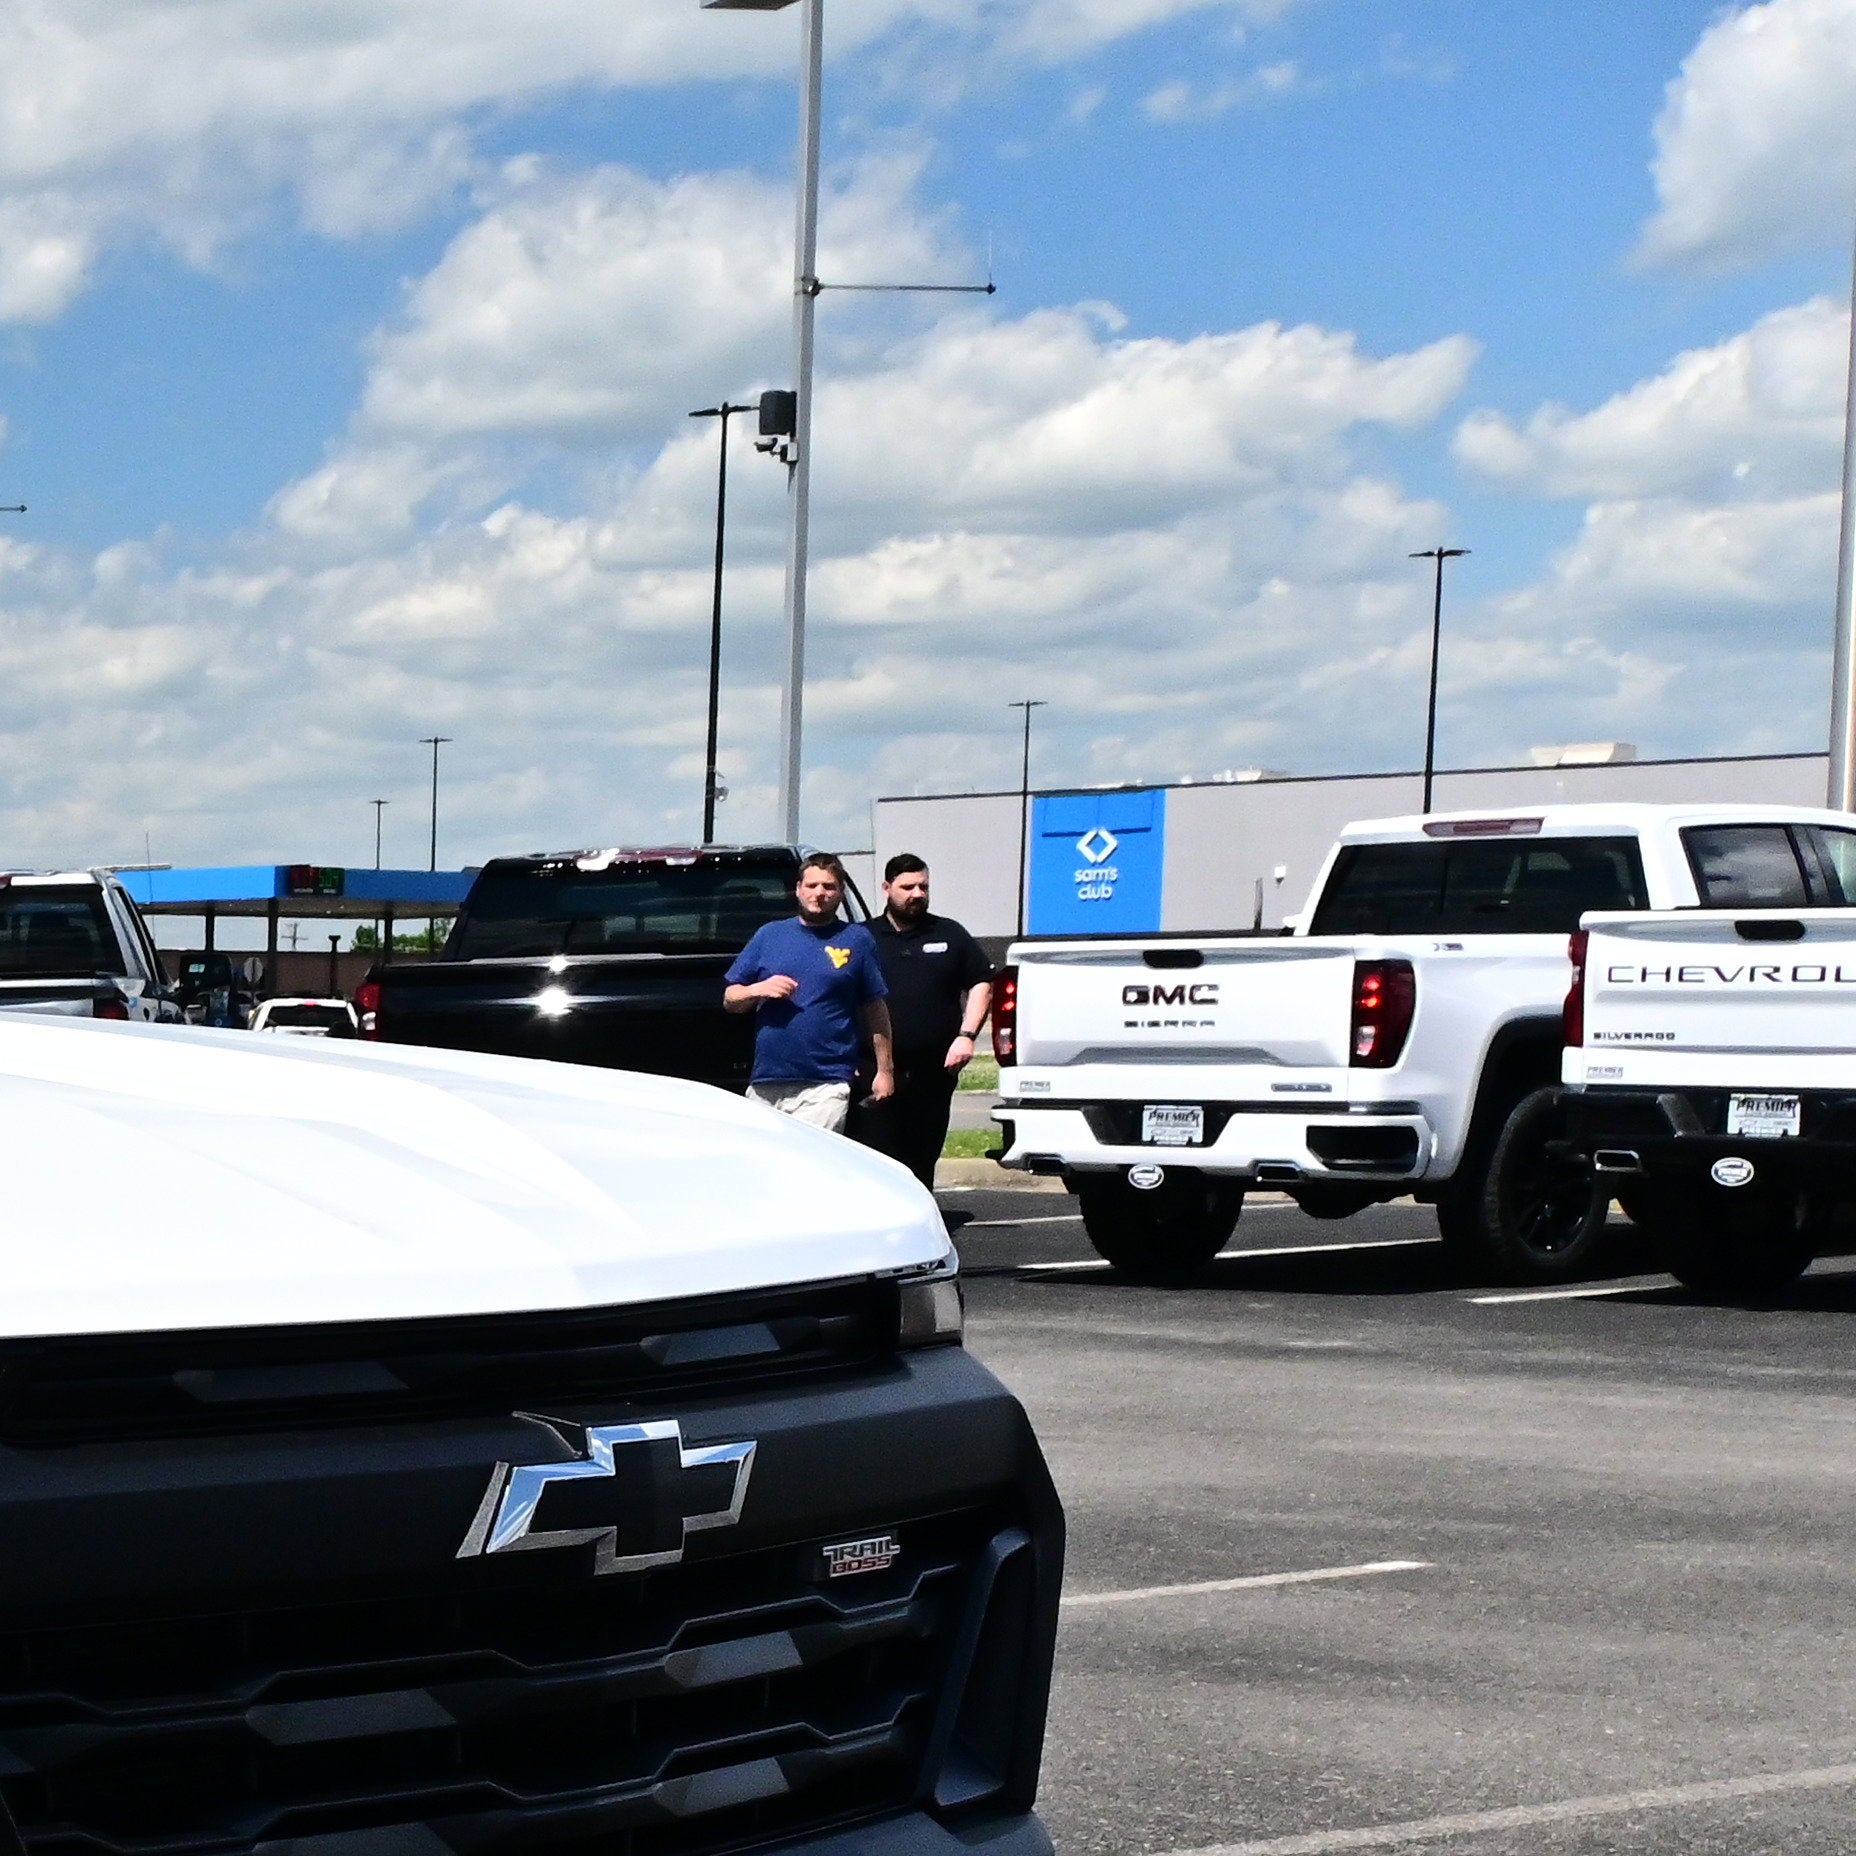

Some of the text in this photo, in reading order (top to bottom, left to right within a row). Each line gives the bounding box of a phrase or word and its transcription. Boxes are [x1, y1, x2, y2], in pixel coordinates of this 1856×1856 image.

[1074, 867, 1119, 883] sam's
[1078, 883, 1113, 900] club
[1607, 965, 1856, 983] CHEVROL
[1122, 984, 1219, 1005] GMC
[1593, 1031, 1675, 1041] SILVERADO
[1149, 1111, 1200, 1128] PREMIER
[823, 1536, 901, 1561] TRAIL
[830, 1553, 892, 1578] BOSS
